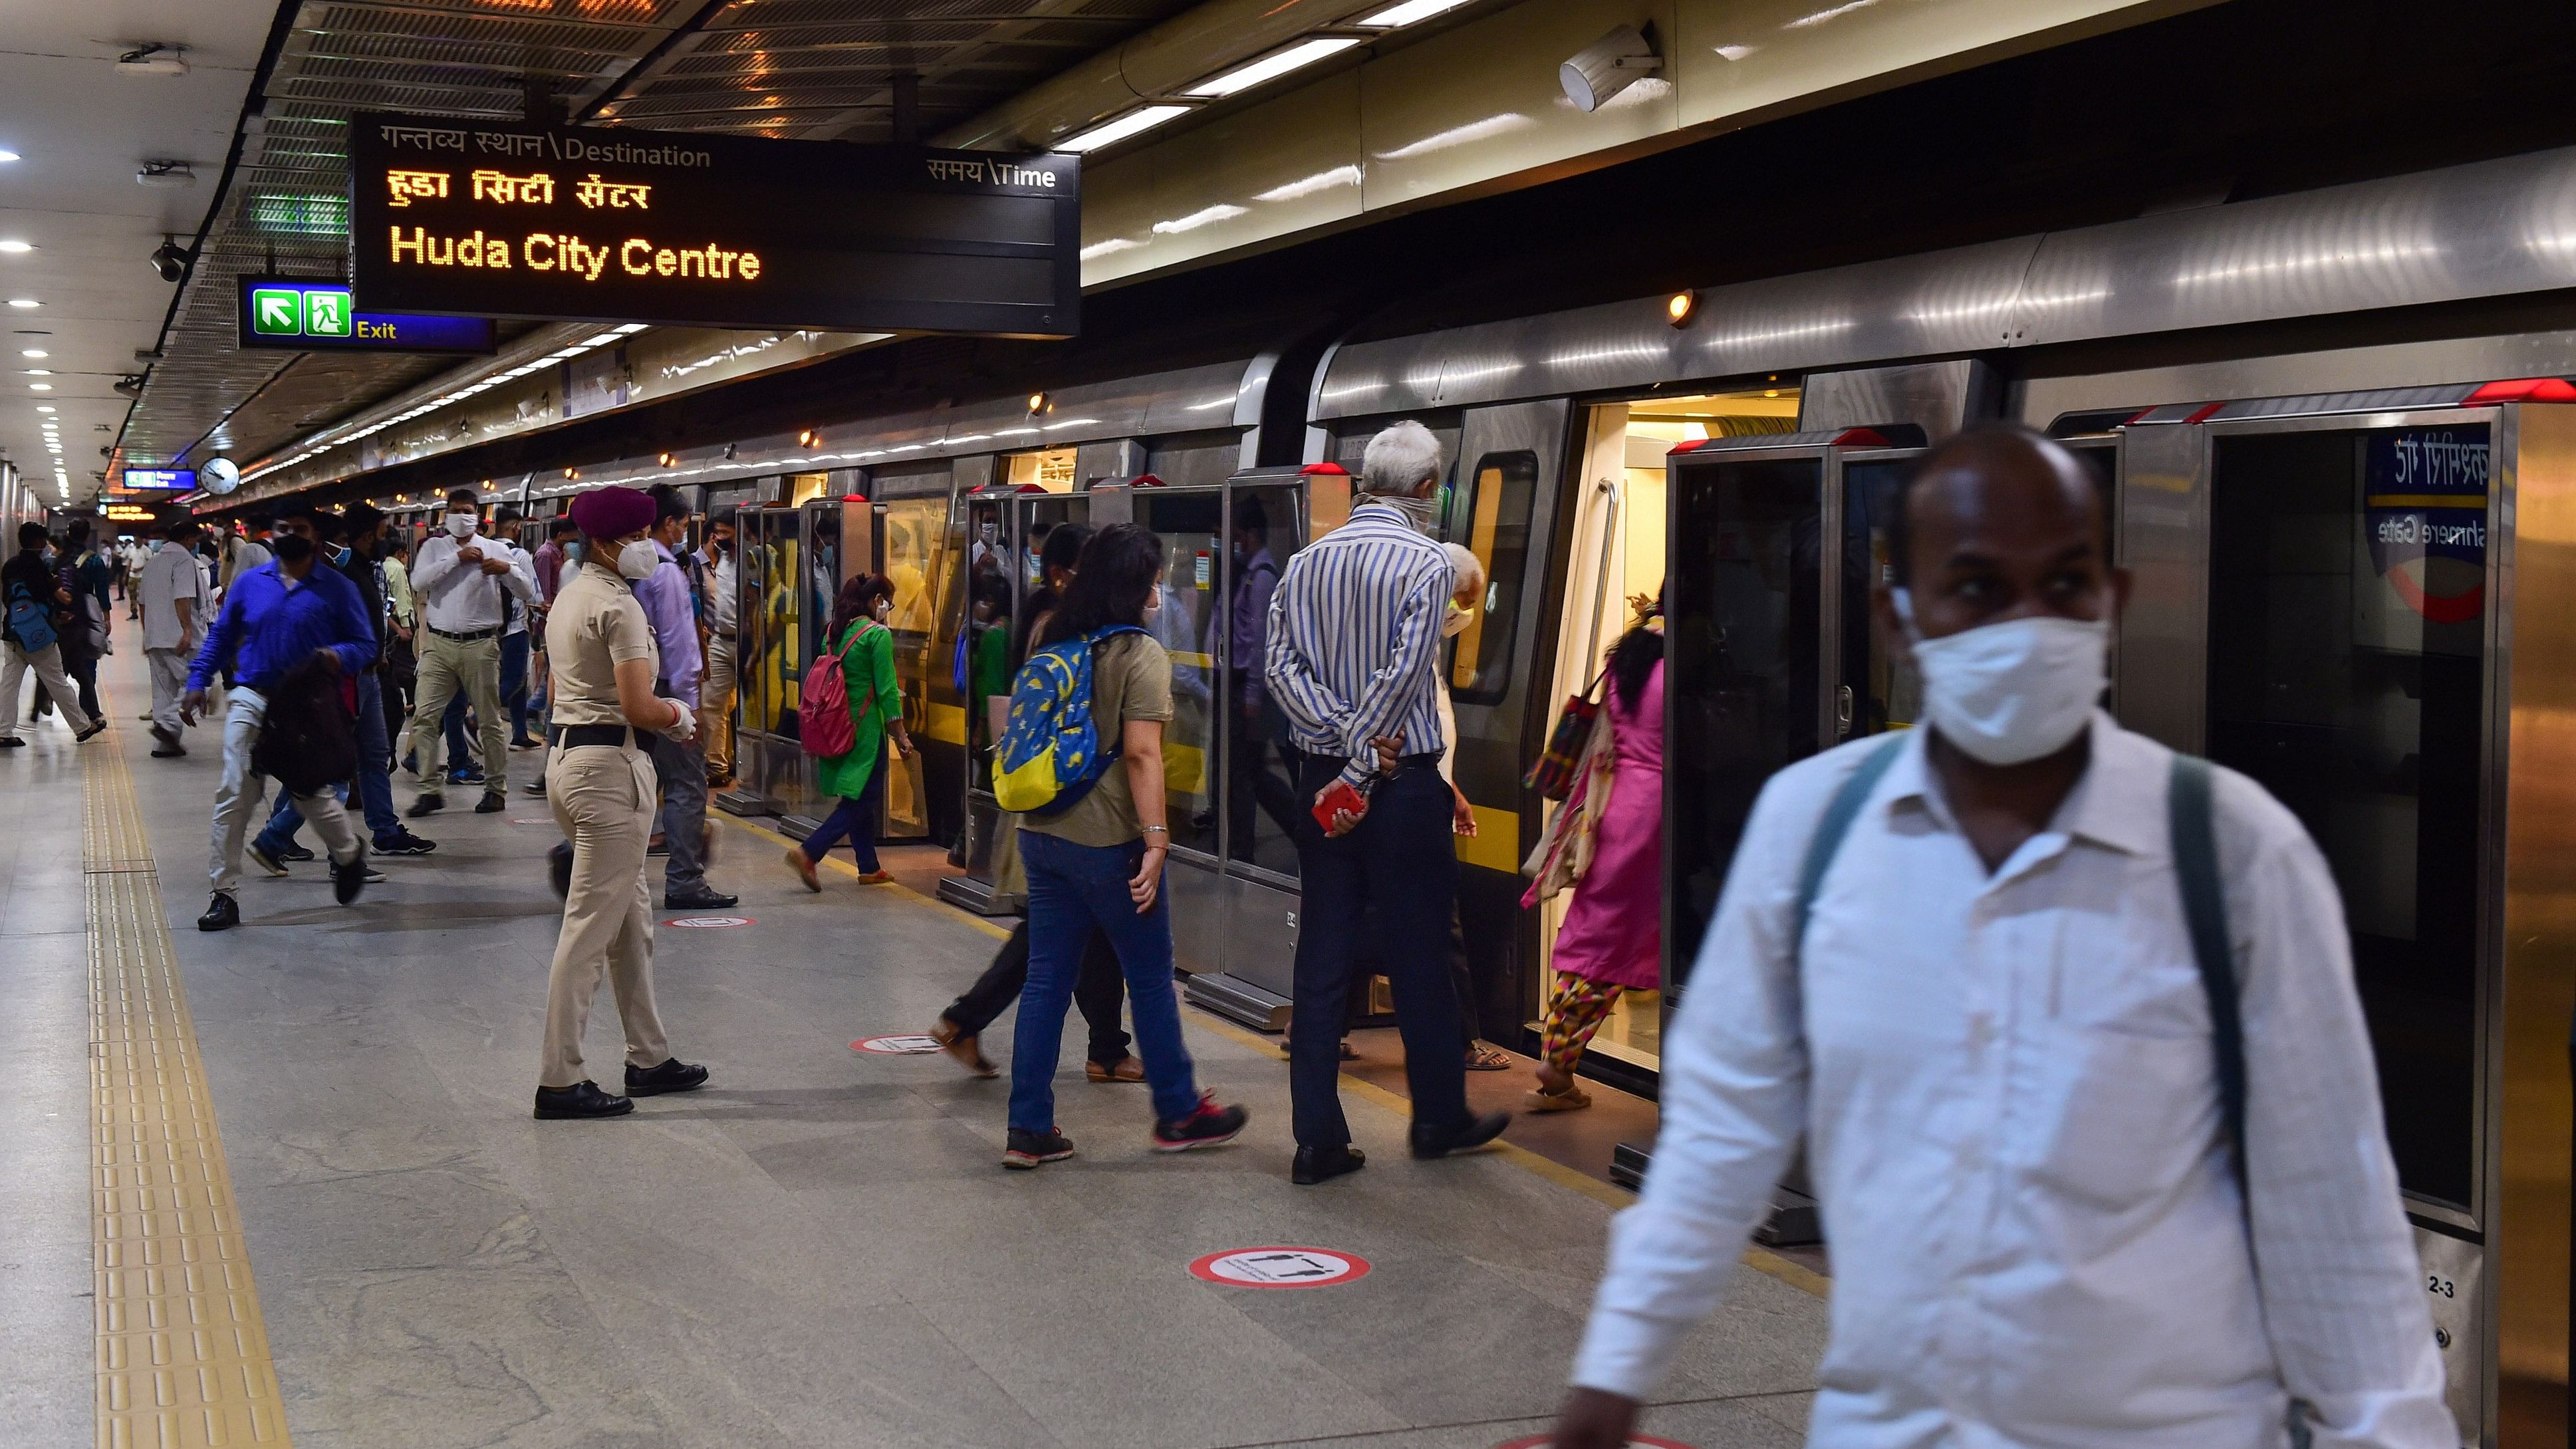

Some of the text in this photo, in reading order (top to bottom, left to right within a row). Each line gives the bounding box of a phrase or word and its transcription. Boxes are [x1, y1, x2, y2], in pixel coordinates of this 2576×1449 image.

[380, 124, 467, 152] गन्तव्य
[926, 159, 984, 183] समय
[388, 170, 450, 207] हुडा
[471, 170, 555, 204] सिटी
[390, 225, 761, 281] Huda City Centre
[357, 321, 397, 340] Exit
[2428, 1275, 2454, 1299] 2-3
